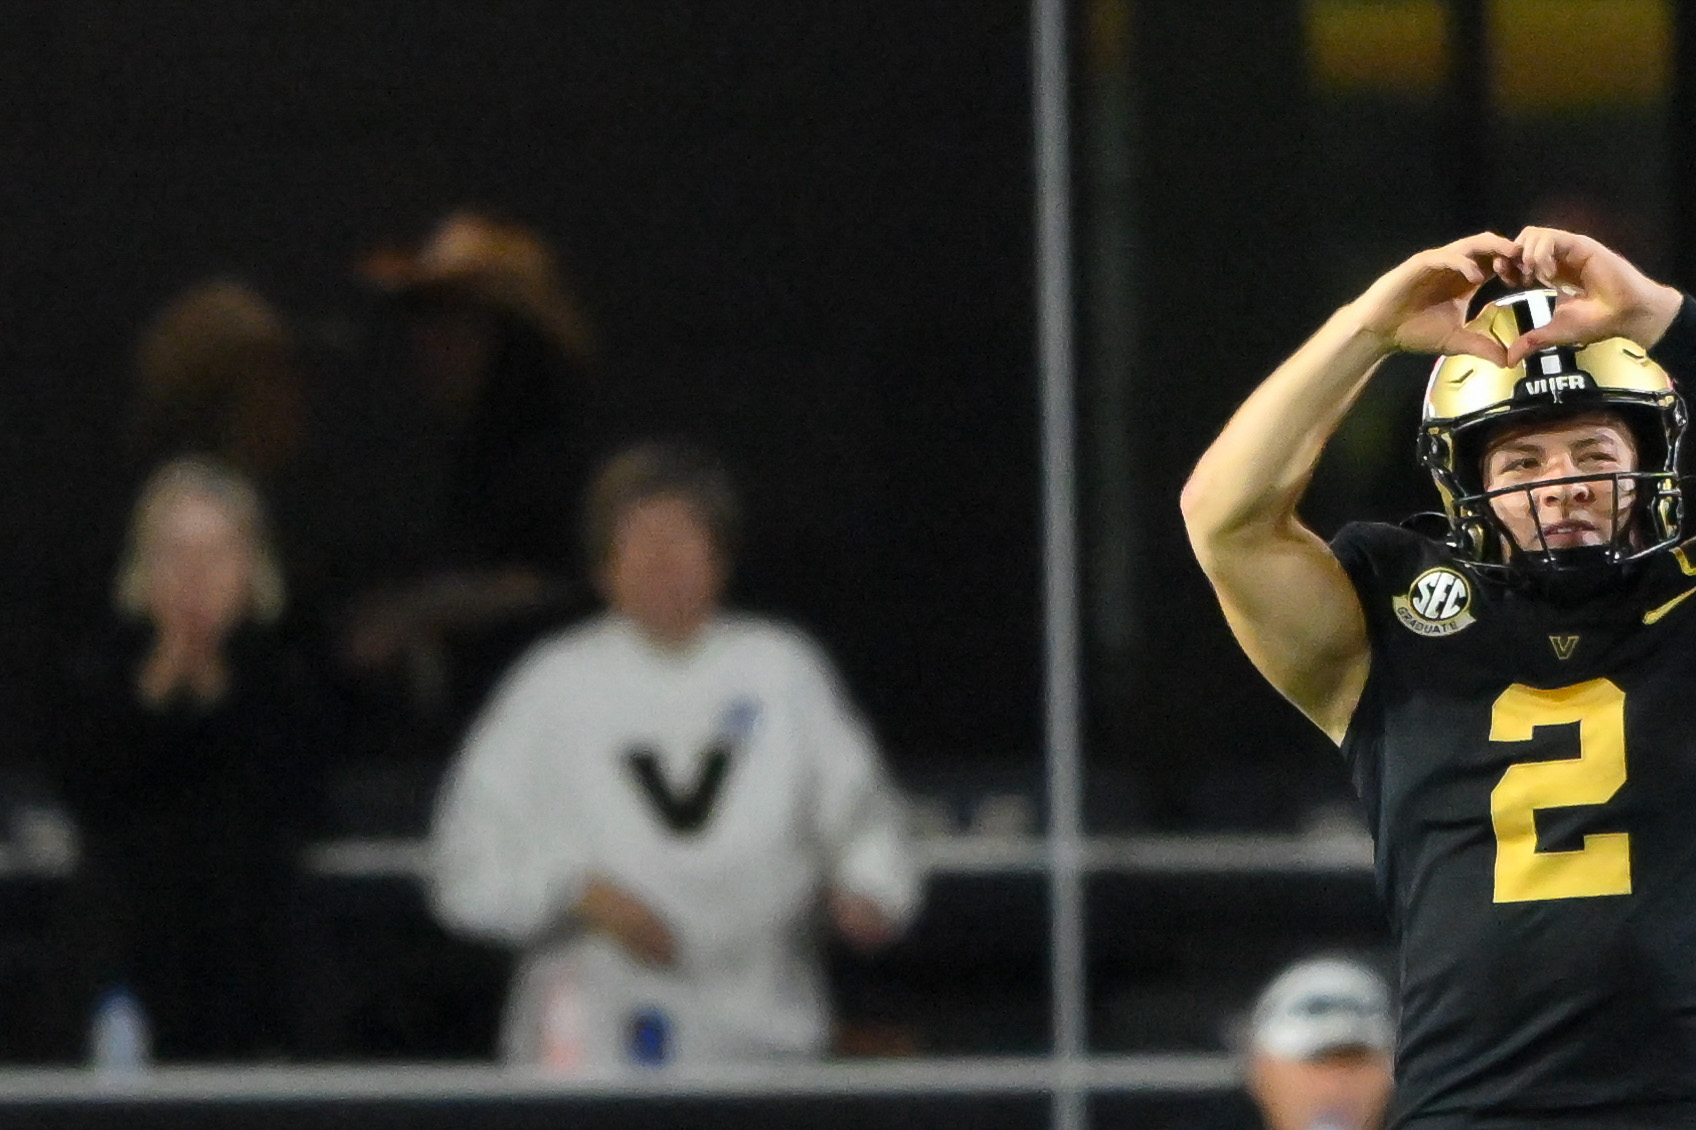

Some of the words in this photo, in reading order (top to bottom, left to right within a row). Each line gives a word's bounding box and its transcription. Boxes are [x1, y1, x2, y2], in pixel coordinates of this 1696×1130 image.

[1412, 571, 1467, 620] SEC
[1396, 606, 1459, 635] GRADUATE
[1549, 635, 1580, 660] V
[1488, 677, 1632, 903] 2
